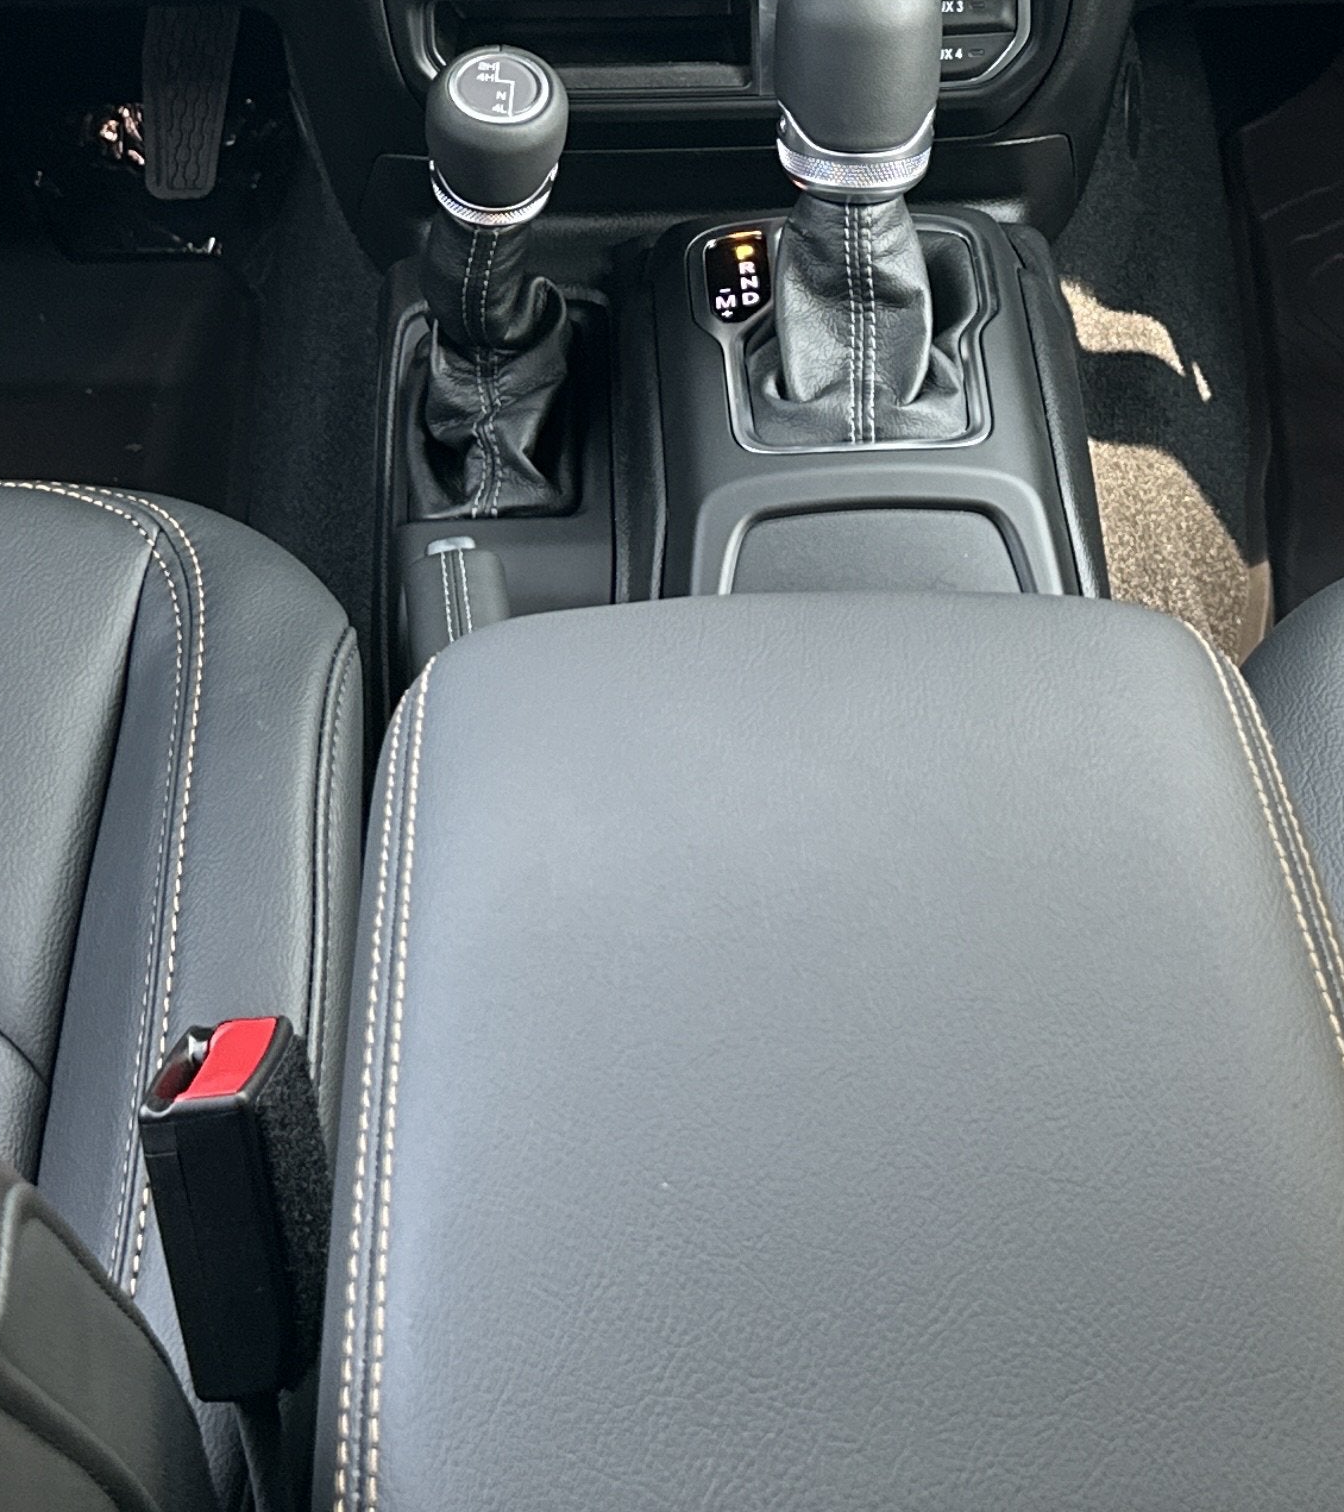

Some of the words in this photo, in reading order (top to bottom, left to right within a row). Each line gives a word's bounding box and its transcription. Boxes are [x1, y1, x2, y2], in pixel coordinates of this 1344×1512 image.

[956, 0, 964, 13] 3
[955, 48, 963, 60] 4
[476, 72, 495, 82] 4H
[496, 90, 507, 101] N
[492, 103, 507, 114] 4L
[738, 261, 755, 275] R
[740, 276, 758, 290] N
[715, 294, 736, 309] M
[741, 292, 760, 306] D
